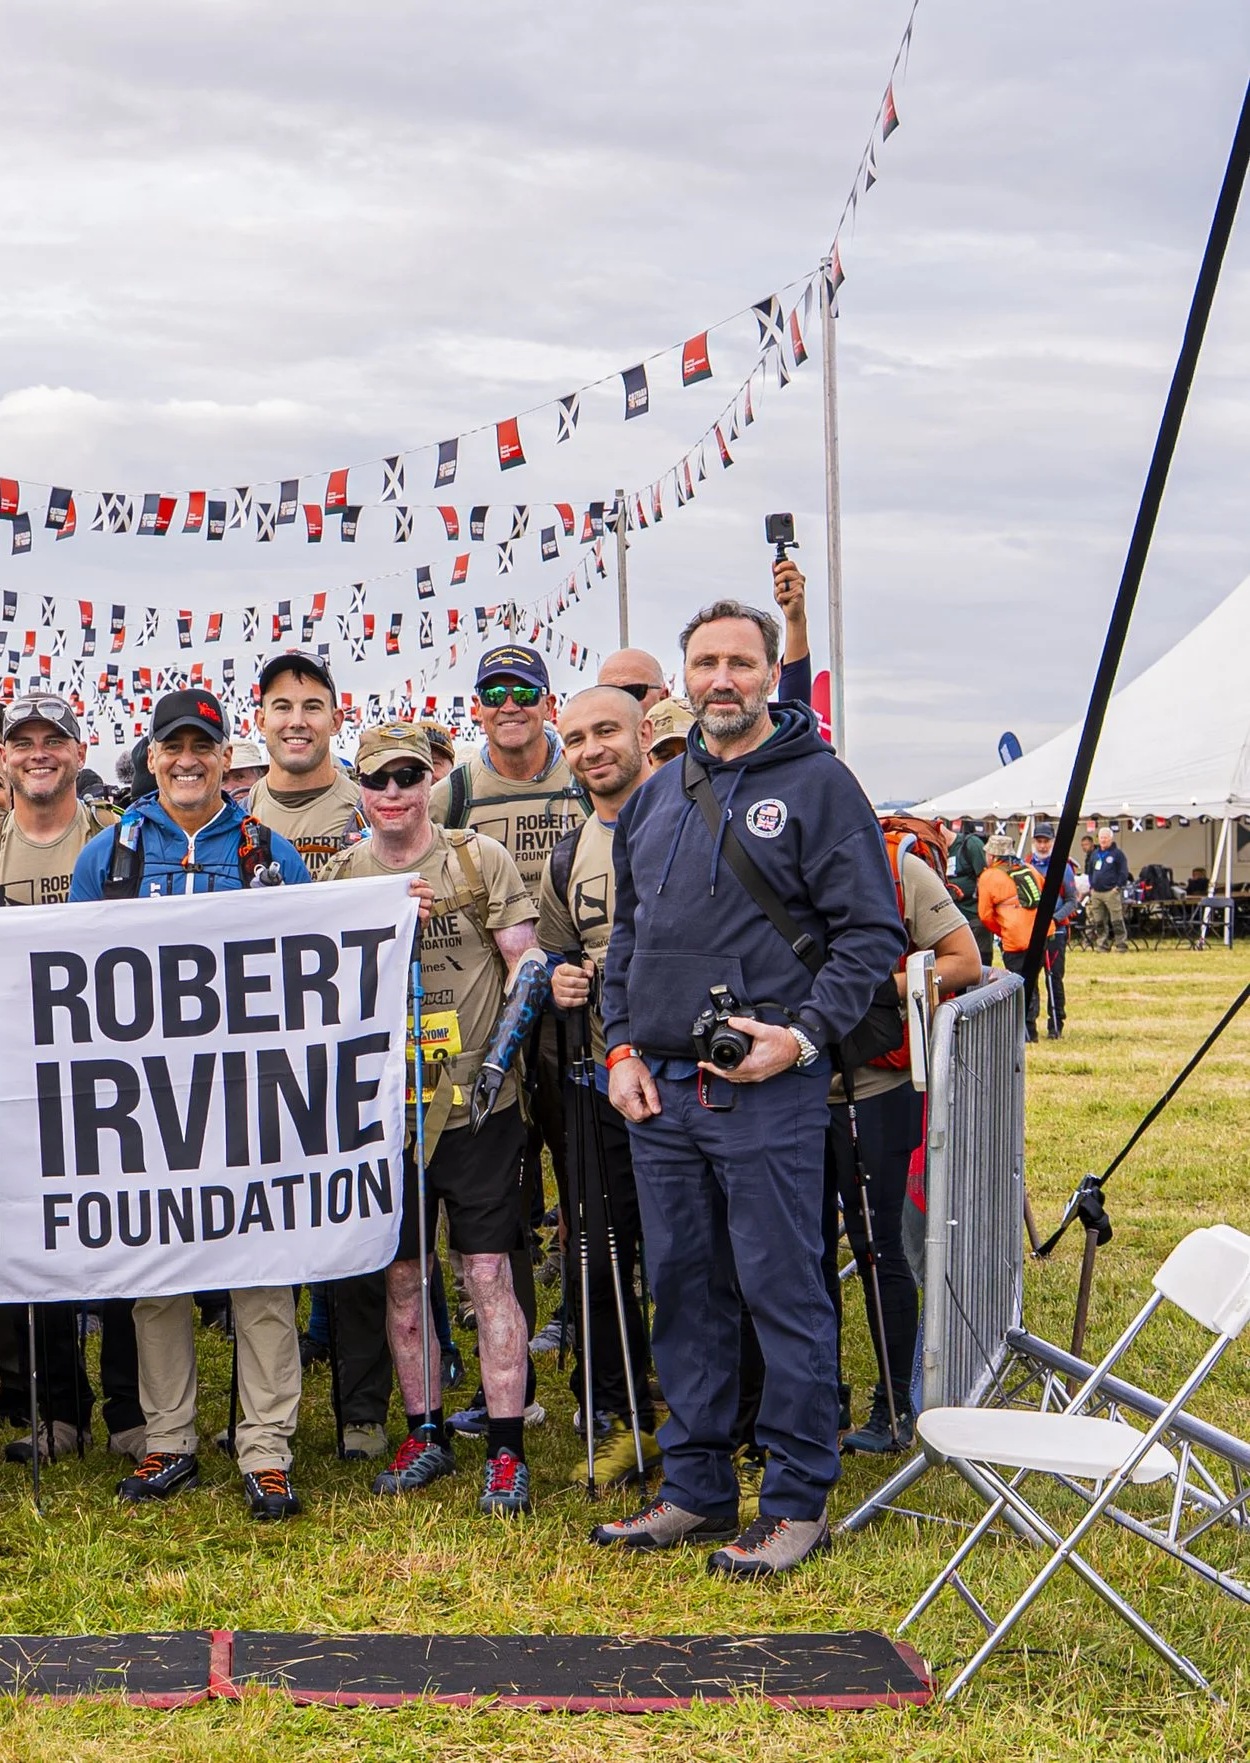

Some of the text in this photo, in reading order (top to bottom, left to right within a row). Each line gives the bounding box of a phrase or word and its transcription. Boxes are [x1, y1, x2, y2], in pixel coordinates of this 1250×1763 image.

[517, 813, 578, 831] ROBERT
[41, 874, 73, 893] ROB
[428, 915, 461, 938] INE
[420, 962, 446, 973] lines
[30, 925, 397, 1047] ROBERT
[426, 1028, 449, 1040] YOMP
[35, 1032, 391, 1178] IRVINE
[44, 1158, 393, 1250] FOUNDATION
